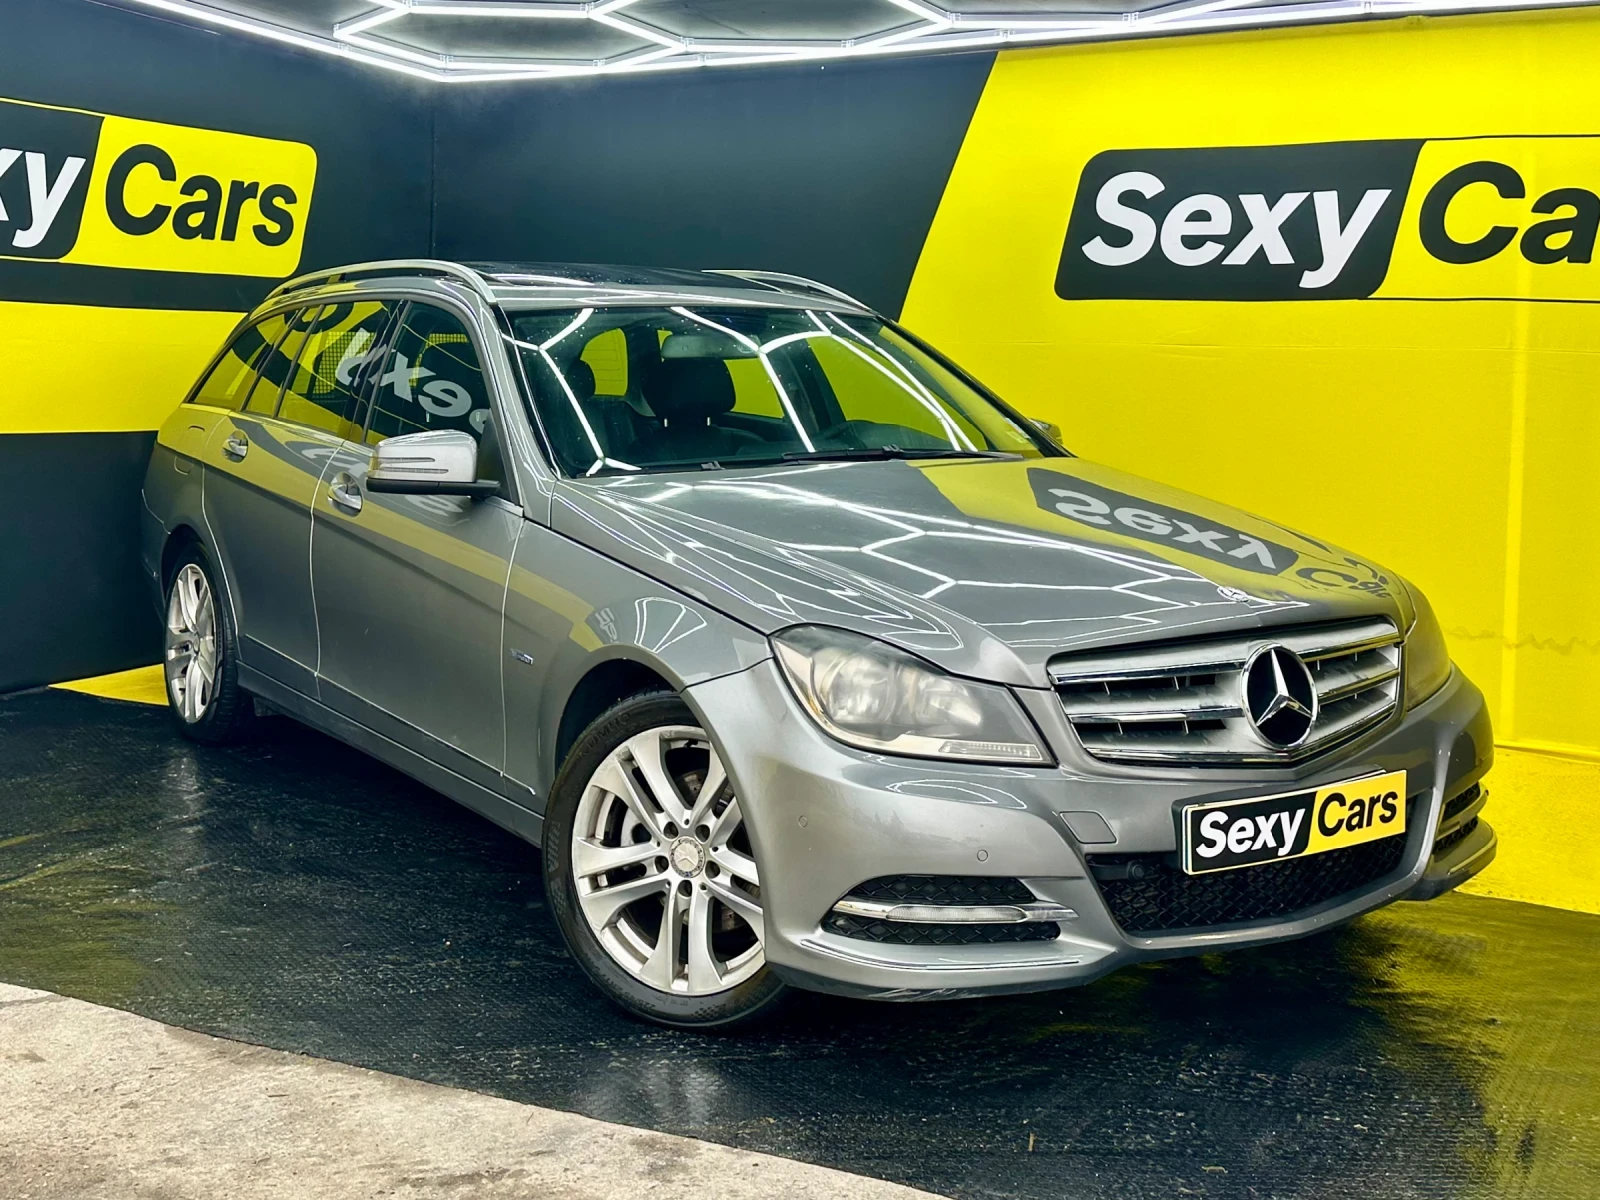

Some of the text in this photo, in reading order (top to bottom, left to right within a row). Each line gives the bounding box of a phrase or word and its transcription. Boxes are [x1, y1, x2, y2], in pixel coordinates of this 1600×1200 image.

[105, 143, 298, 247] Cars
[1081, 171, 1392, 288] Sexy
[1196, 791, 1398, 858] Sexy Cars
